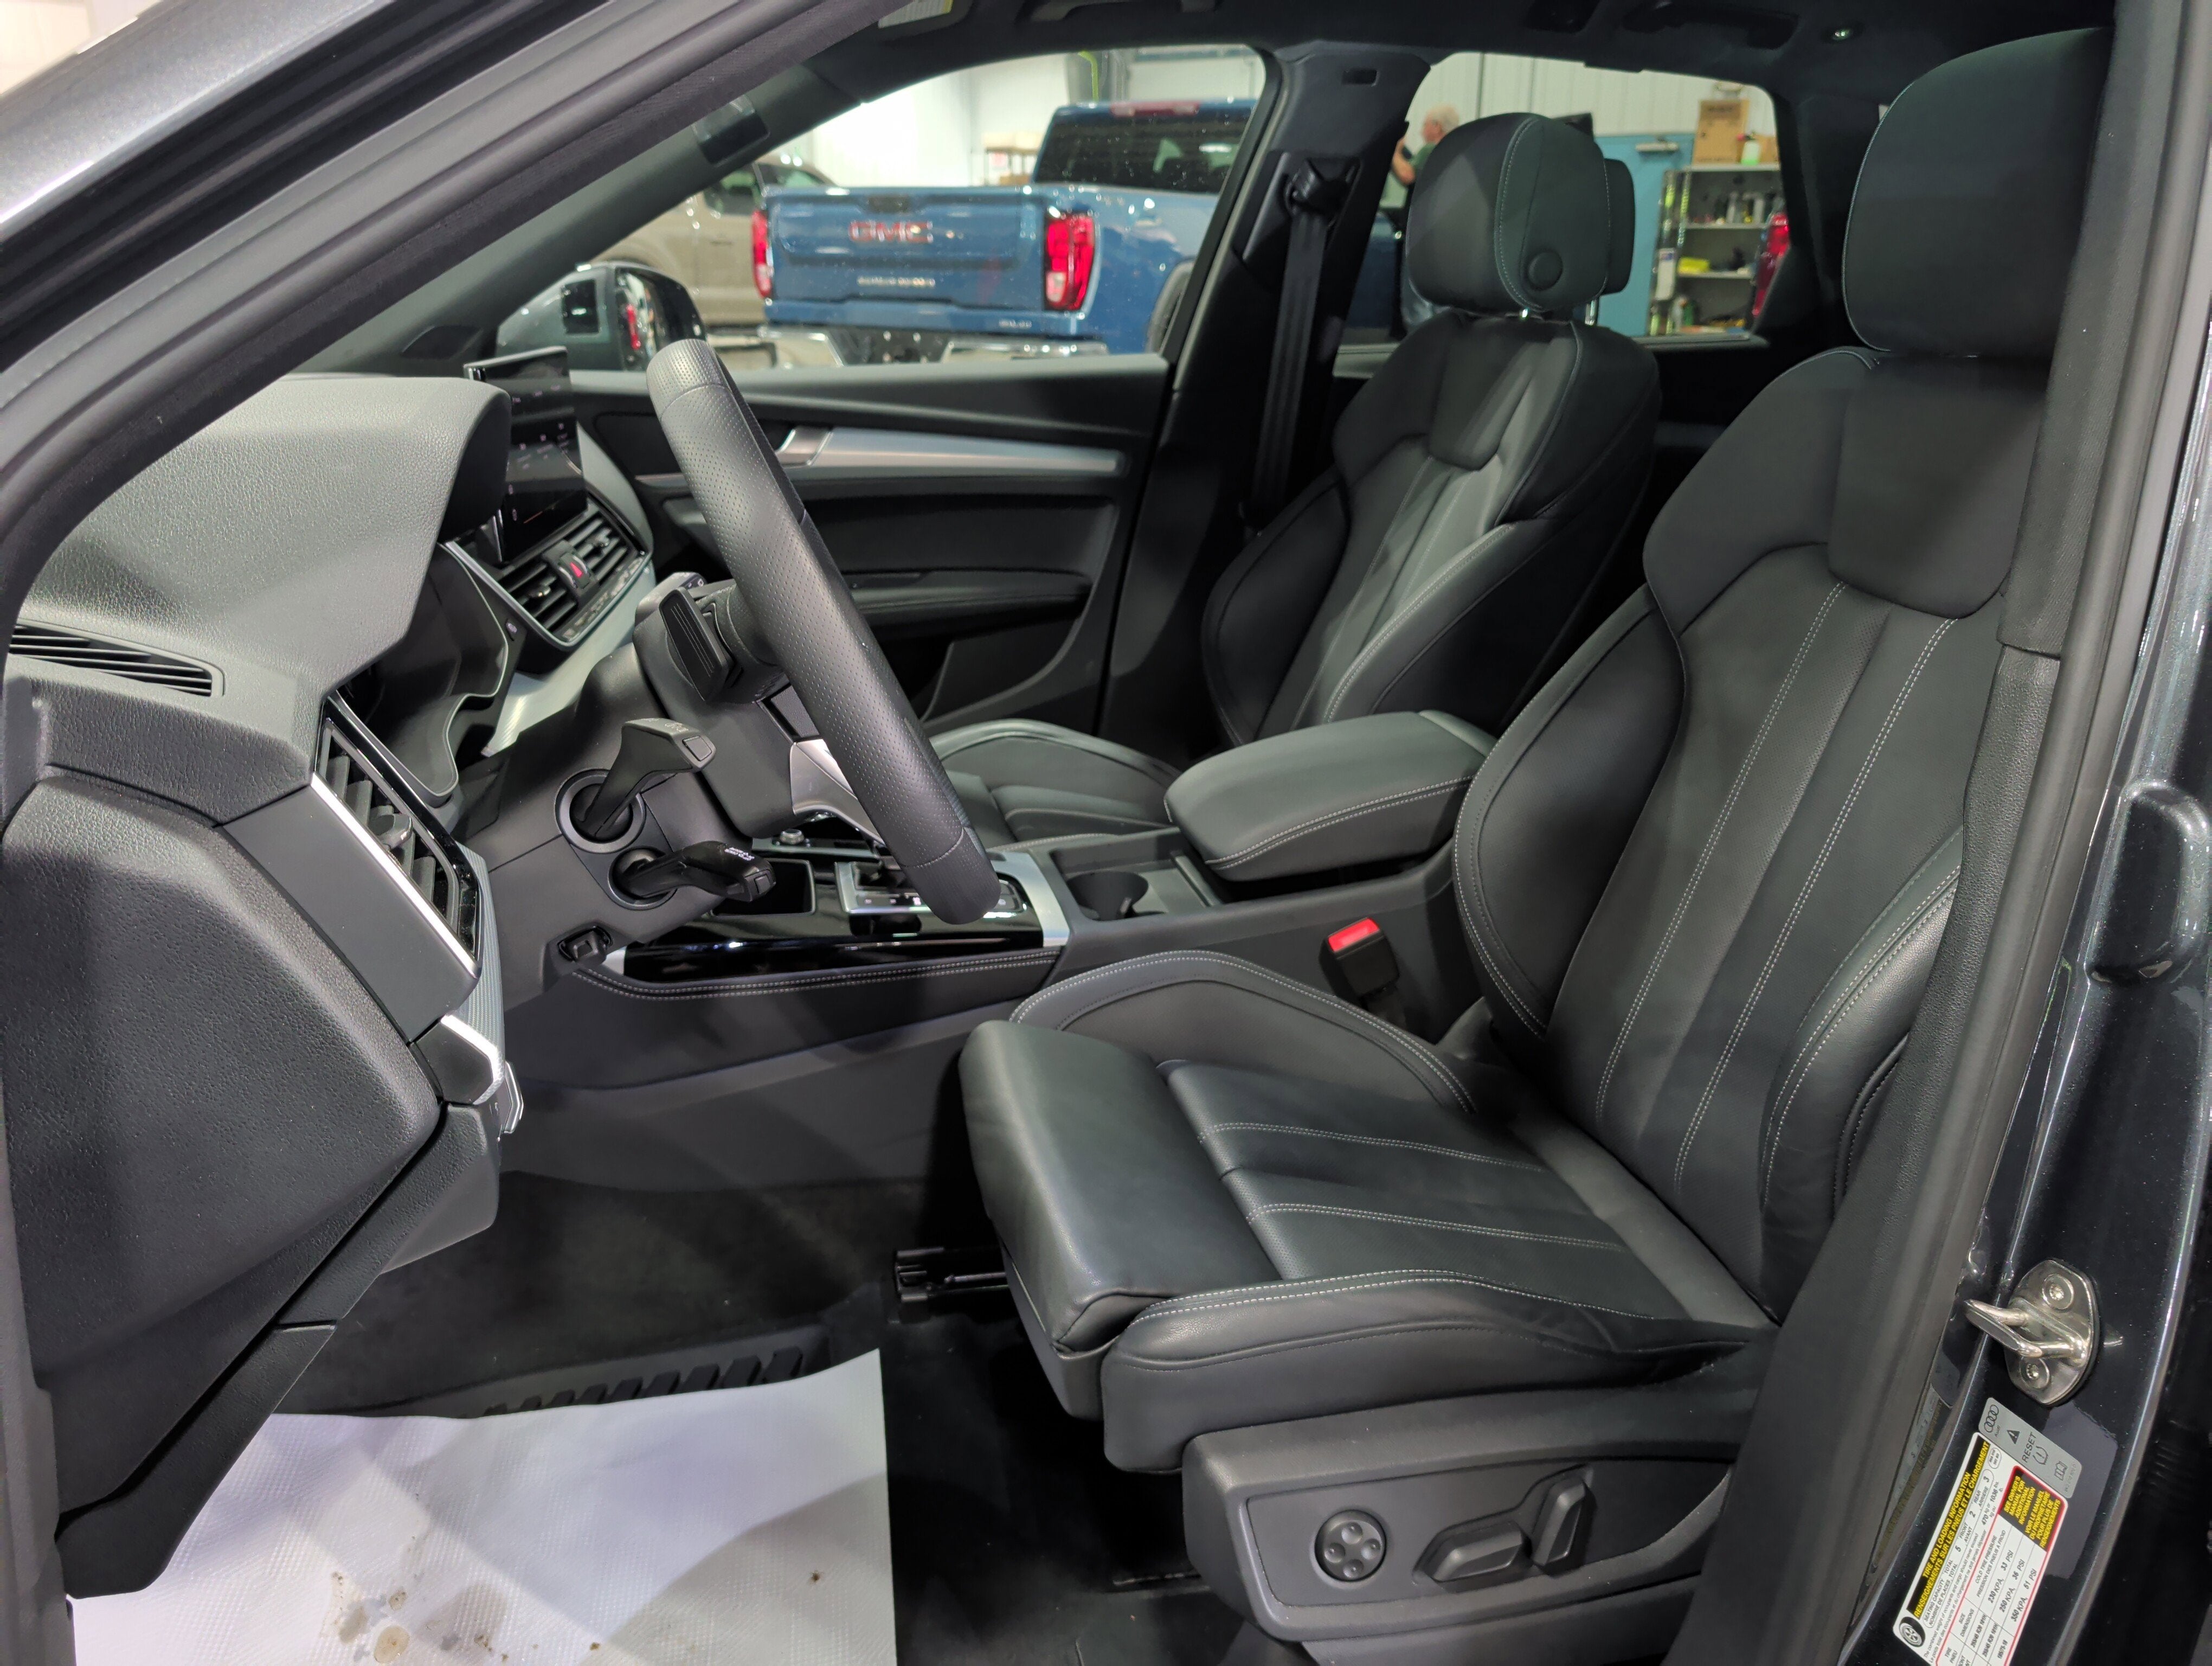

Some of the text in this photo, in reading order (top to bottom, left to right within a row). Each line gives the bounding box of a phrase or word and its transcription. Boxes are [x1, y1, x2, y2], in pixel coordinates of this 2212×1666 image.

[848, 219, 934, 242] GMC
[2021, 1431, 2036, 1463] RESET
[1973, 1489, 1981, 1503] REAR
[1980, 1513, 1989, 1525] 470
[1990, 1488, 1998, 1503] 1036
[2003, 1475, 2021, 1513] SEE OWNER'S
[2009, 1491, 2021, 1516] MANUAL
[2014, 1485, 2029, 1518] ADDITIONAL
[2018, 1486, 2036, 1525] INFORMATION
[2024, 1489, 2044, 1534] VOIR LE MANUEL
[1914, 1441, 1989, 1617] RENSEIGNEMENTS SUR LES PNEUS ET LE CHARGEMENT
[1922, 1471, 1970, 1579] TIRE AND LOADING INFORMATION
[1959, 1522, 1967, 1539] FRONT
[1963, 1526, 1972, 1542] AVANT
[2029, 1529, 2036, 1540] DU
[2036, 1499, 2054, 1539] POUR PLUS DE
[2040, 1498, 2061, 1548] RENSEIGNEMENTS
[1976, 1574, 1988, 1597] PRESSION
[1989, 1548, 1998, 1565] PNEUS
[1997, 1529, 2005, 1545] FROID
[1984, 1535, 1997, 1560] PRESSURE
[1924, 1559, 1953, 1622] SEATING CAPACITY TOTAL
[1928, 1604, 1939, 1626] NOMBRE
[1940, 1579, 1950, 1598] PLACES
[1949, 1562, 1957, 1578] TOTAL
[1988, 1590, 1996, 1603] 230
[2000, 1561, 2008, 1571] 33
[2005, 1549, 2014, 1562] PSI
[1998, 1599, 2008, 1612] 250
[2011, 1570, 2019, 1580] 36
[2016, 1558, 2025, 1571] PSI
[2010, 1608, 2020, 1622] 350
[2023, 1580, 2030, 1590] 51
[2028, 1568, 2037, 1581] PSI
[1959, 1608, 1975, 1637] DIMENSIONS
[1949, 1650, 1957, 1663] PNEU
